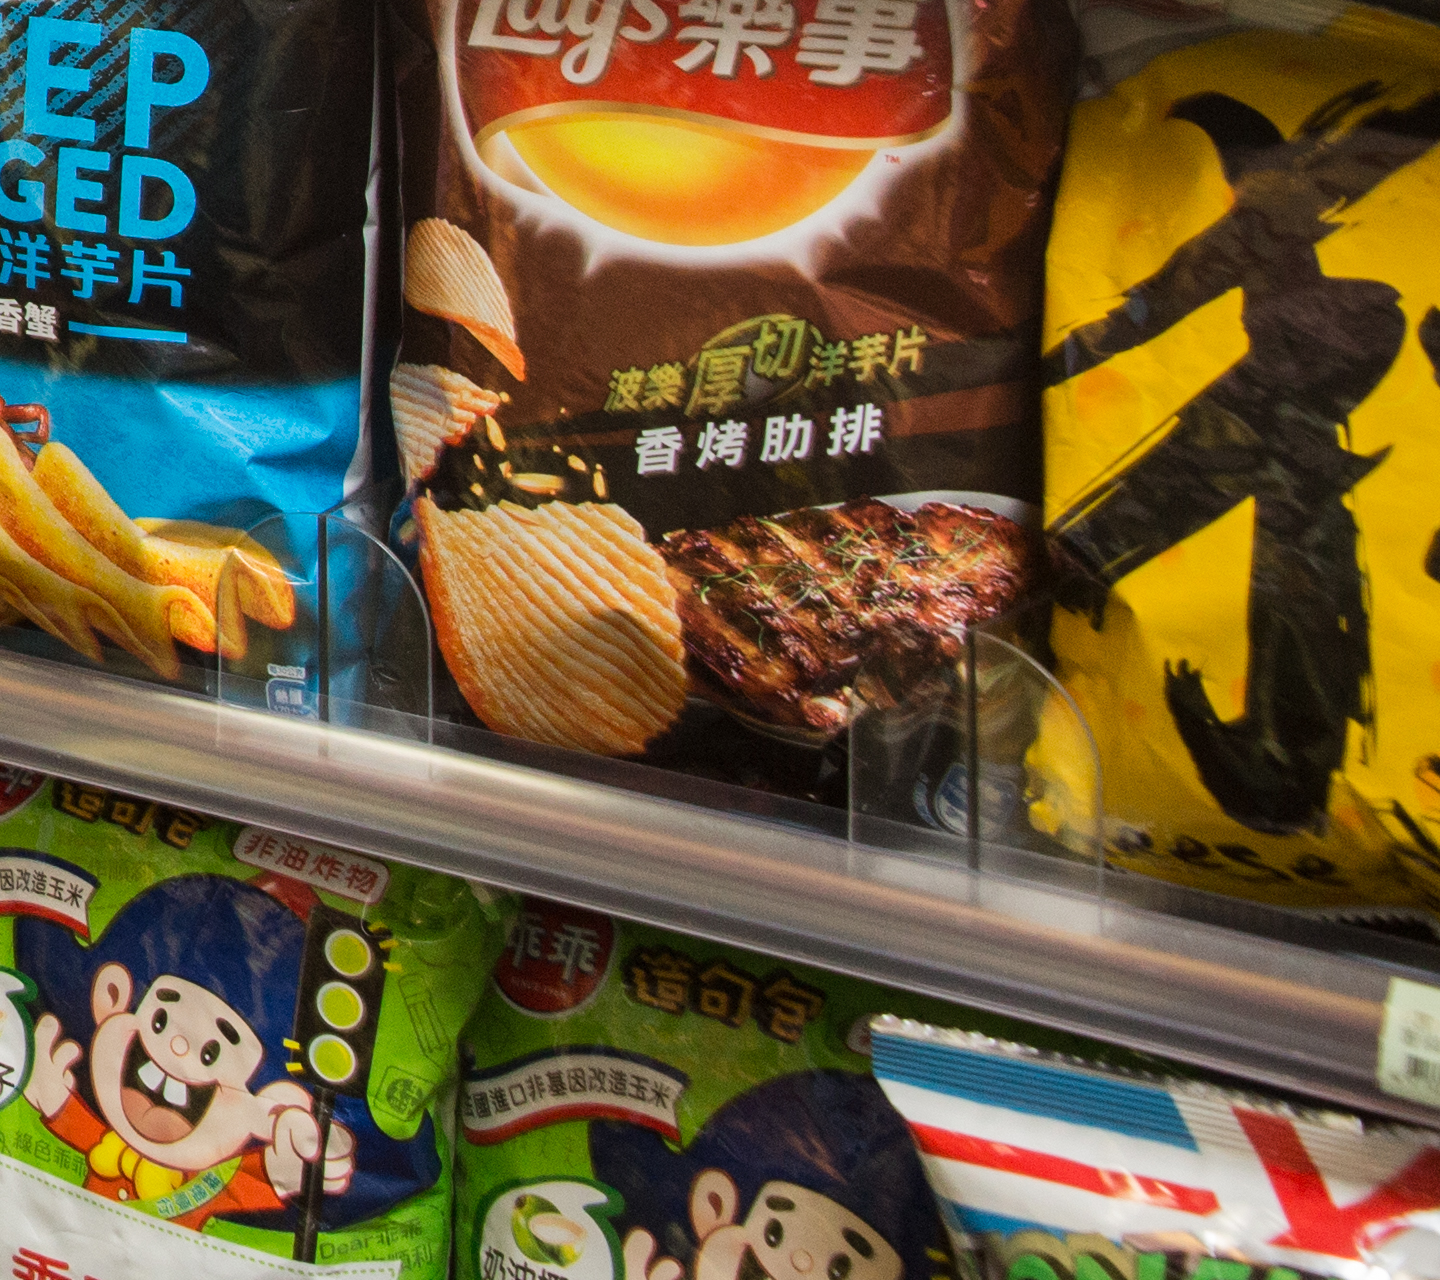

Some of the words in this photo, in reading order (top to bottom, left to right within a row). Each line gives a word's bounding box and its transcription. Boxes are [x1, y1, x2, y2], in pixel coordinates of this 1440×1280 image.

[634, 402, 883, 476] 香烤肋排
[243, 830, 379, 897] 非油炸物
